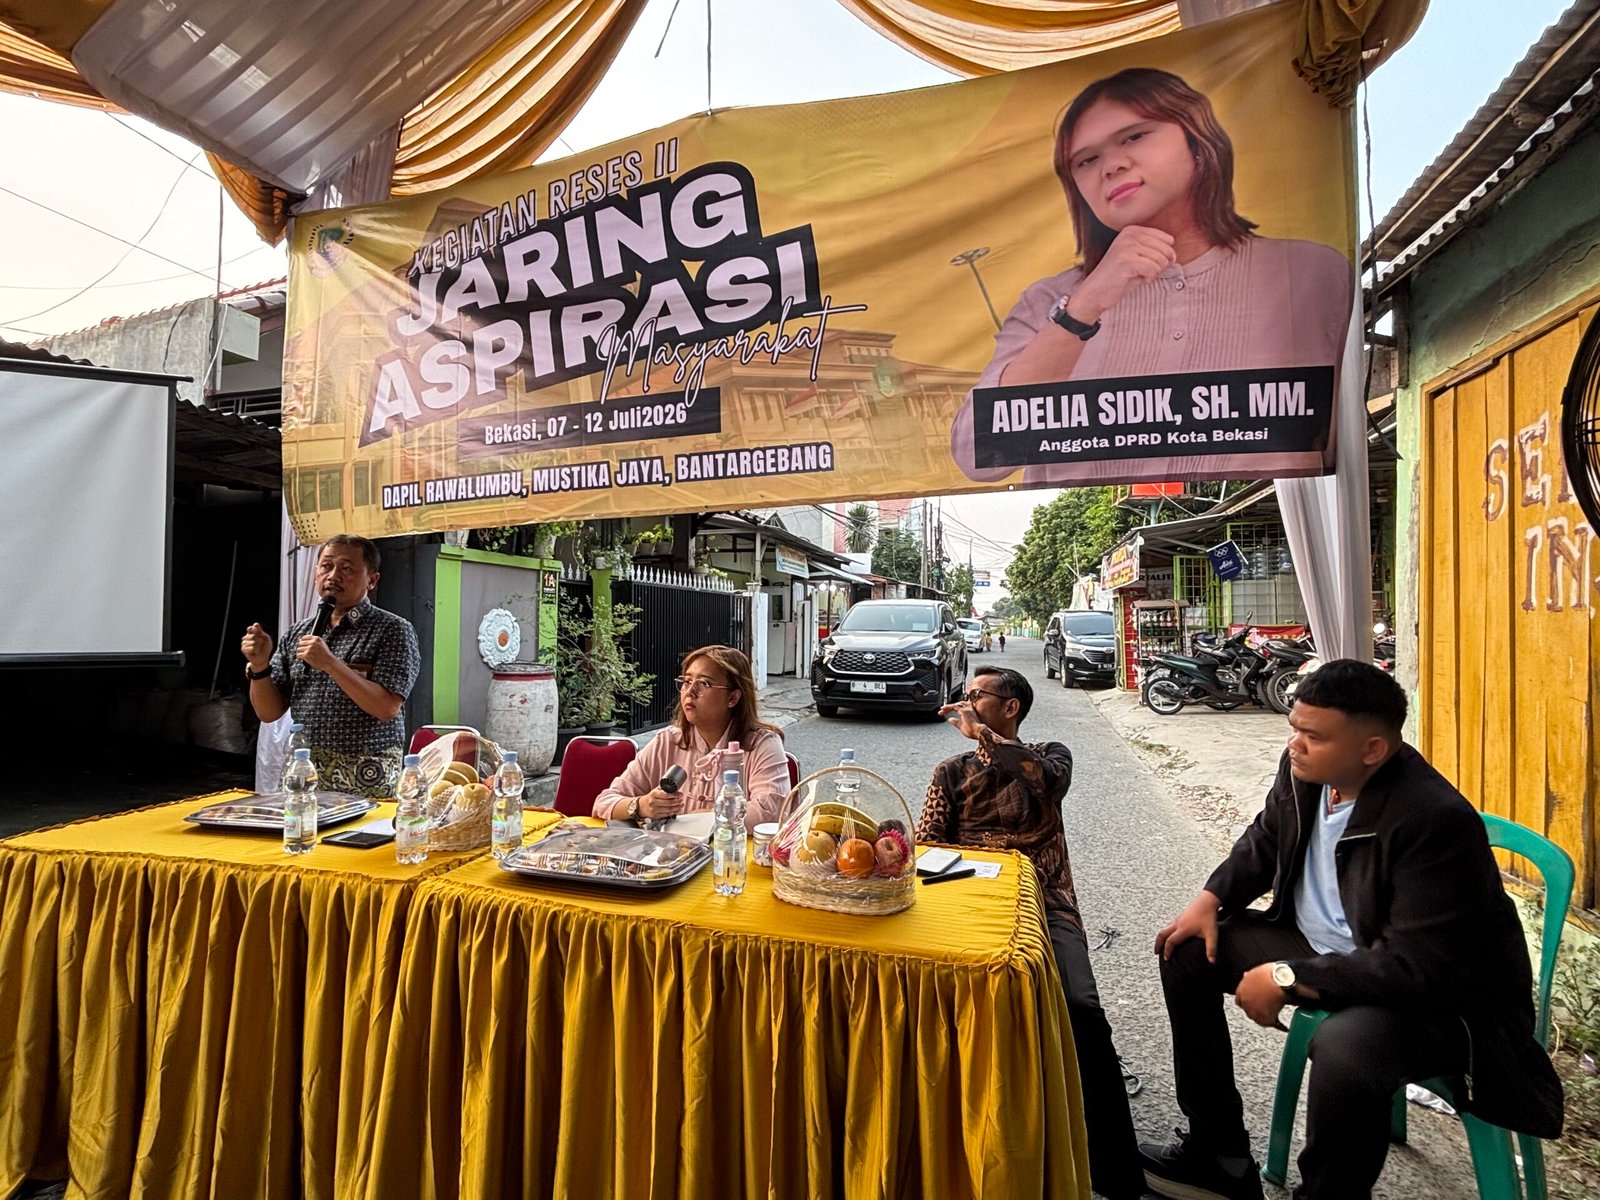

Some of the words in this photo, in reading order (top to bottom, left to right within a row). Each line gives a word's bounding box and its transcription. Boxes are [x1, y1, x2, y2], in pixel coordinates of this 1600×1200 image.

[410, 189, 538, 278] KEGIATAN
[548, 150, 642, 220] RESES
[654, 137, 680, 178] II
[396, 171, 749, 337] JARING
[368, 240, 808, 434] ASPIRASI
[595, 295, 868, 406] Masyarakat
[484, 420, 543, 446] Bekasi,
[546, 414, 568, 438] 07
[584, 411, 604, 435] 12
[992, 393, 1090, 434] ADELIA
[1098, 387, 1183, 427] SIDIK,
[1191, 384, 1240, 421] SH.
[1248, 381, 1316, 417] MM.
[1038, 435, 1110, 454] Anggota
[1114, 433, 1162, 448] DPRD
[1167, 430, 1208, 445] Kota
[1212, 427, 1269, 442] Bekasi
[382, 480, 422, 509] DAPIL
[425, 471, 528, 504] RAWALUMBU,
[532, 463, 612, 494] MUSTIKA
[615, 456, 671, 489] JAYA,
[676, 443, 832, 482] BANTARGEBANG
